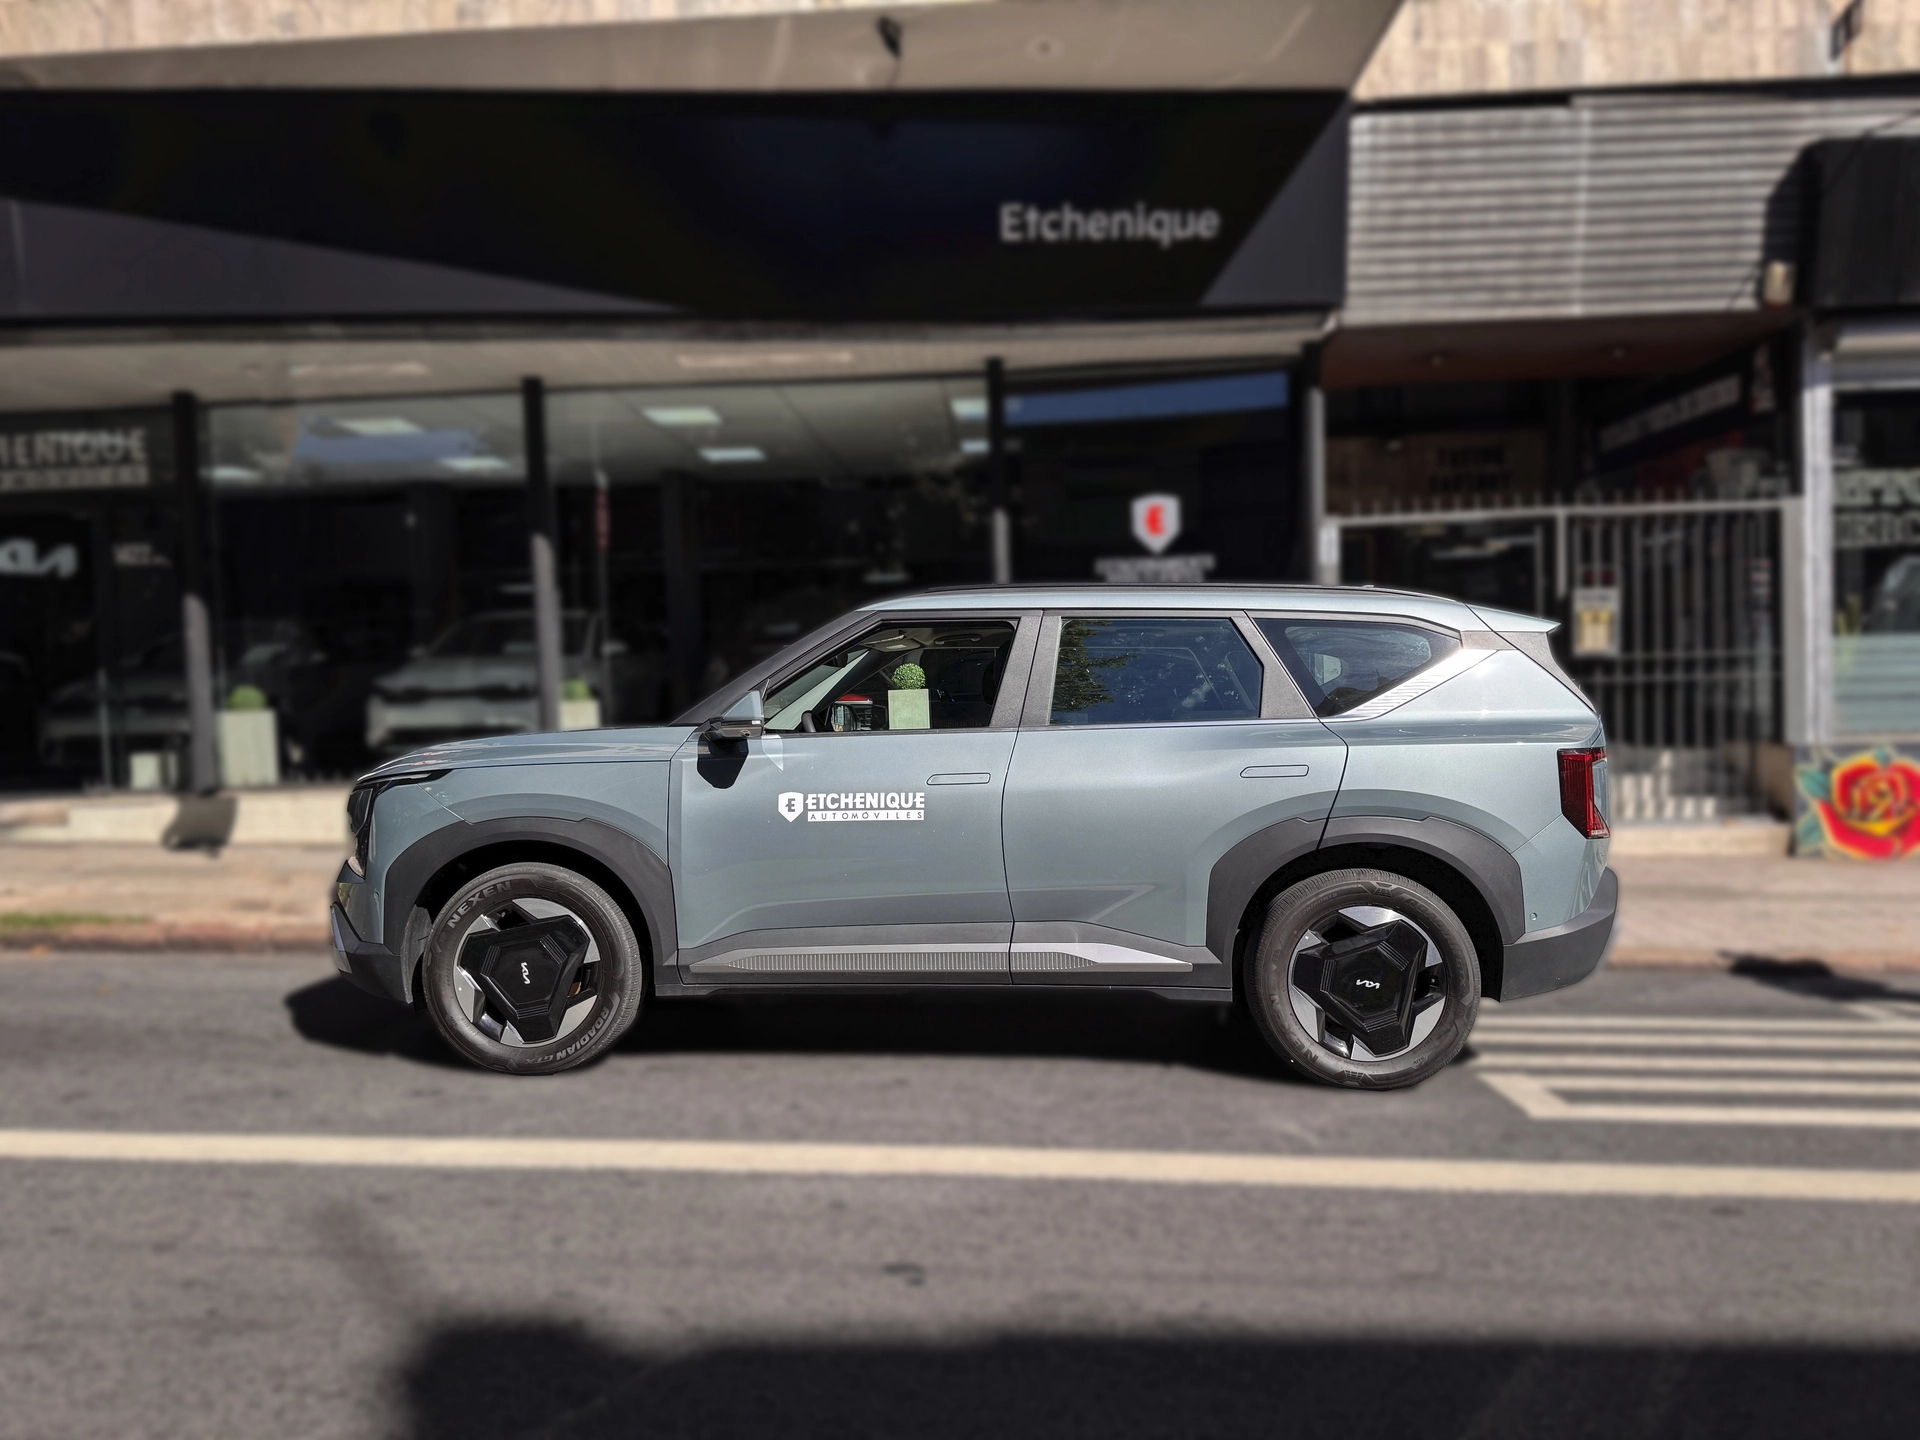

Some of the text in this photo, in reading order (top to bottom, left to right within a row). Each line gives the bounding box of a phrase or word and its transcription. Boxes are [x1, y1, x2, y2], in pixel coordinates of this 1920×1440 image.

[999, 202, 1221, 249] Etchenique
[805, 792, 925, 810] ETCHENIQUE
[810, 811, 923, 820] AUTOMÓVILES
[446, 881, 512, 929] NEXEN
[526, 1006, 610, 1065] ROADIAN GTX
[1270, 994, 1319, 1064] NEXEN
